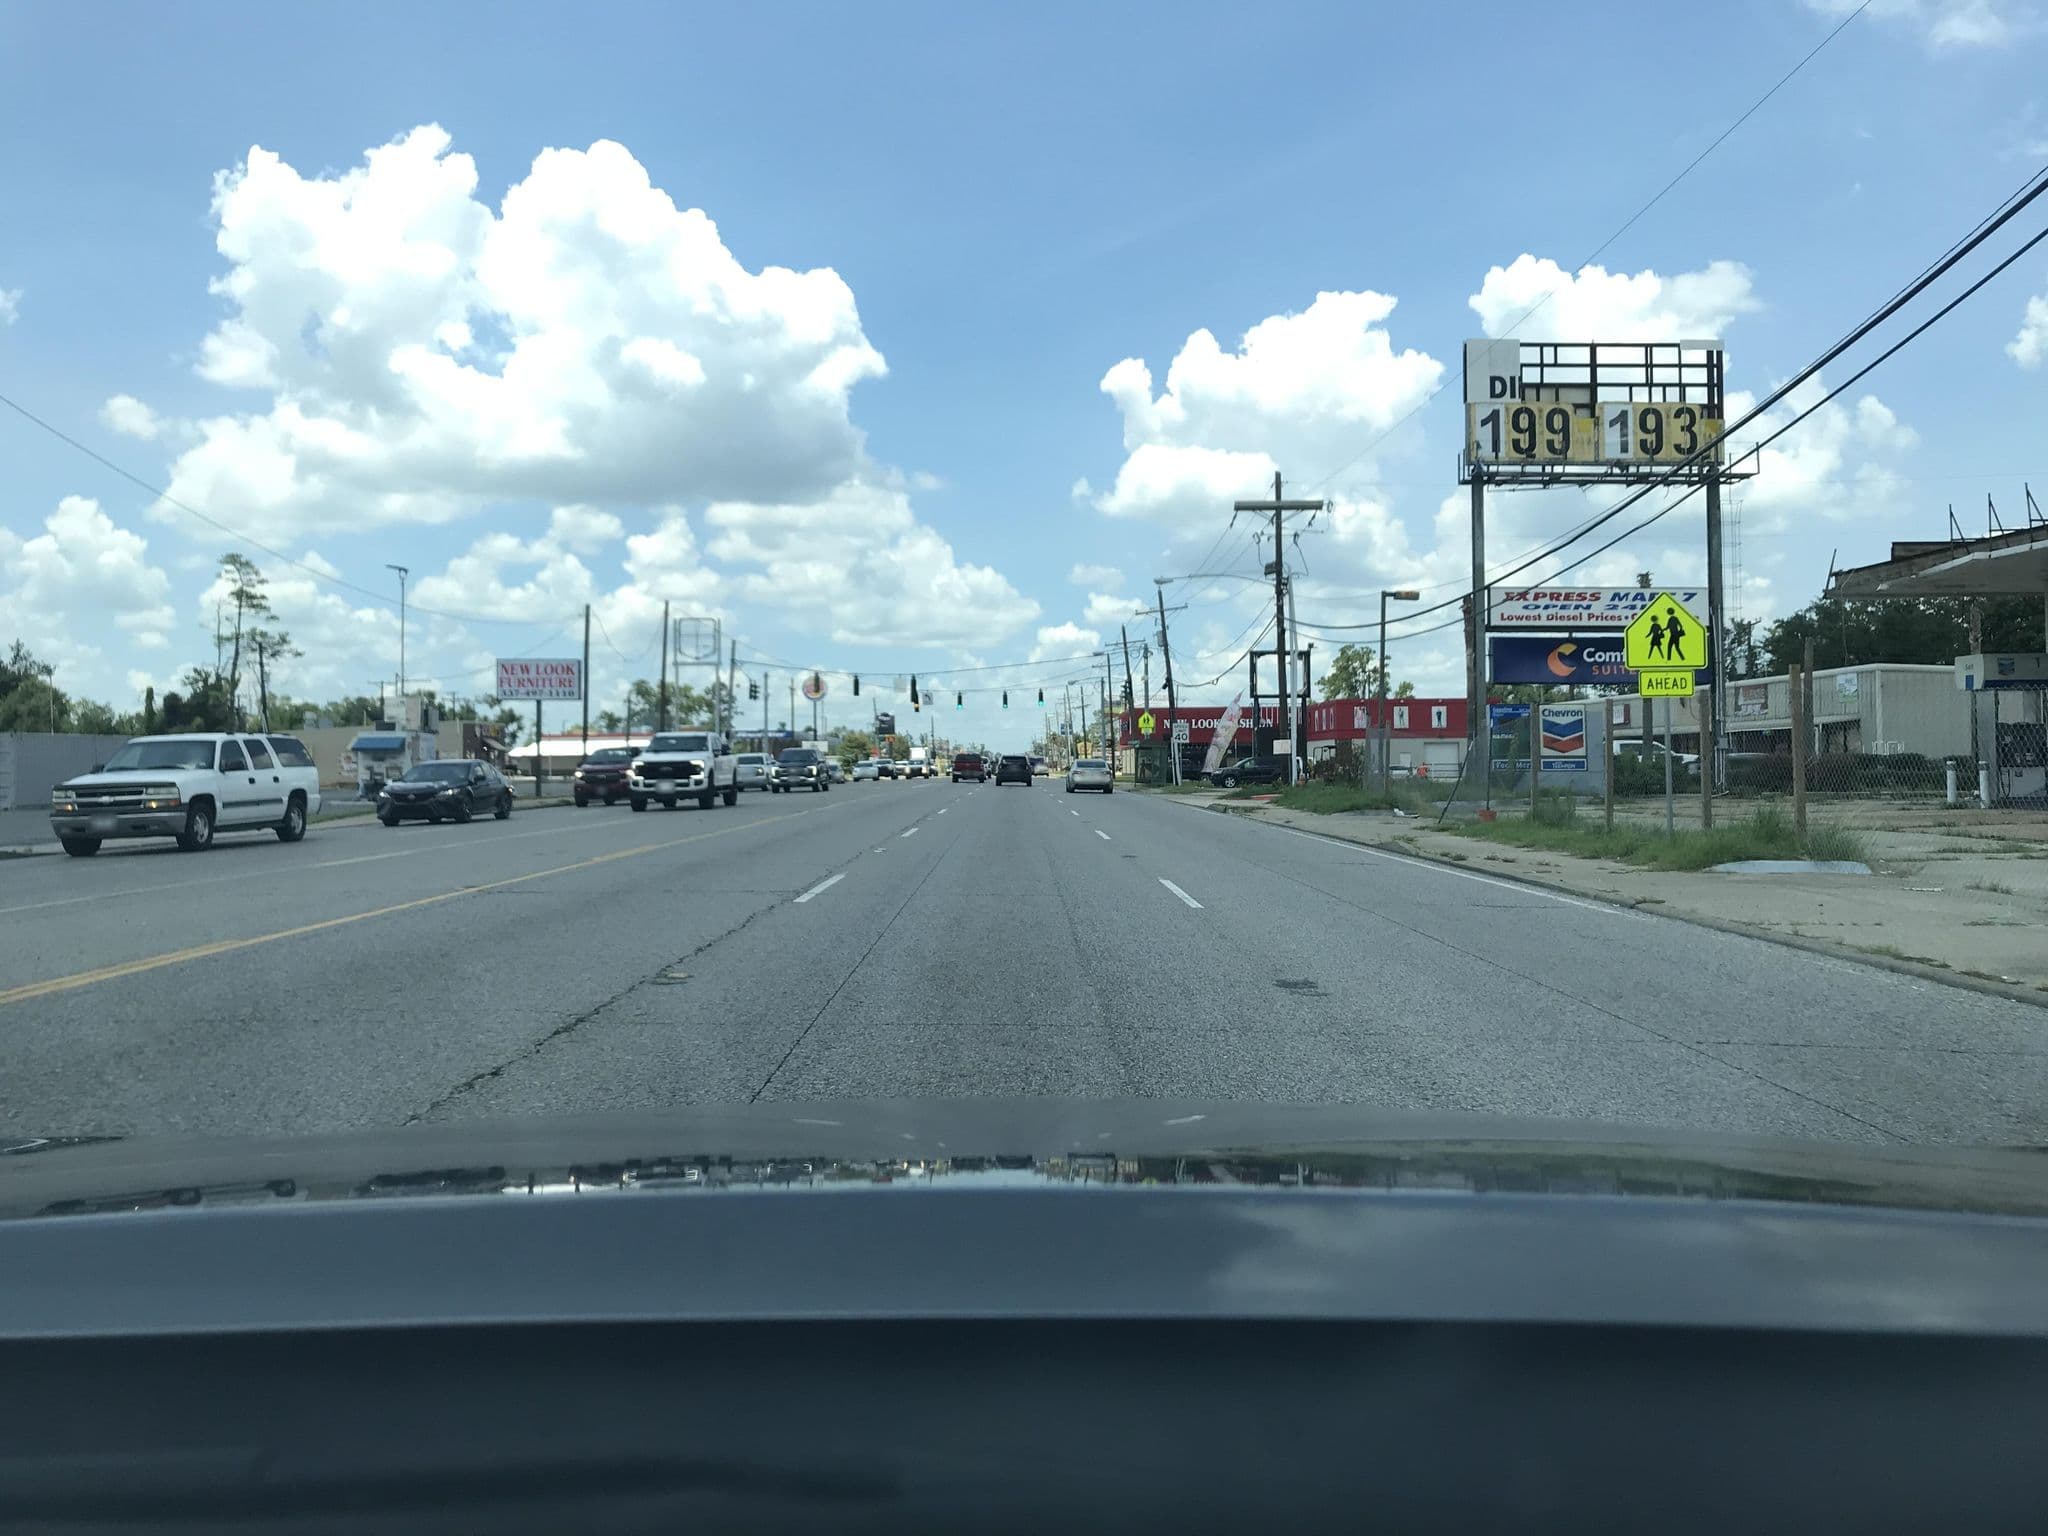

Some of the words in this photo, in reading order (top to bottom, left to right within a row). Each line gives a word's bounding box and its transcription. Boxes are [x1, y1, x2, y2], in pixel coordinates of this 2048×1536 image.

[1489, 375, 1521, 399] DI
[1480, 406, 1571, 456] 199
[1608, 406, 1699, 456] 193
[1503, 591, 1602, 602] EXPRESS
[1609, 591, 1677, 602] MA
[1682, 592, 1698, 602] 7
[1521, 603, 1593, 611] OPEN
[1500, 612, 1541, 621] Lowest
[1546, 612, 1583, 621] Diesel
[1587, 612, 1622, 621] Prices
[501, 663, 530, 675] NEW
[536, 663, 575, 675] LOOK
[500, 677, 574, 688] FURNITURE
[1646, 677, 1688, 690] AHEAD
[1541, 708, 1583, 718] Chevron
[1174, 733, 1188, 741] 40
